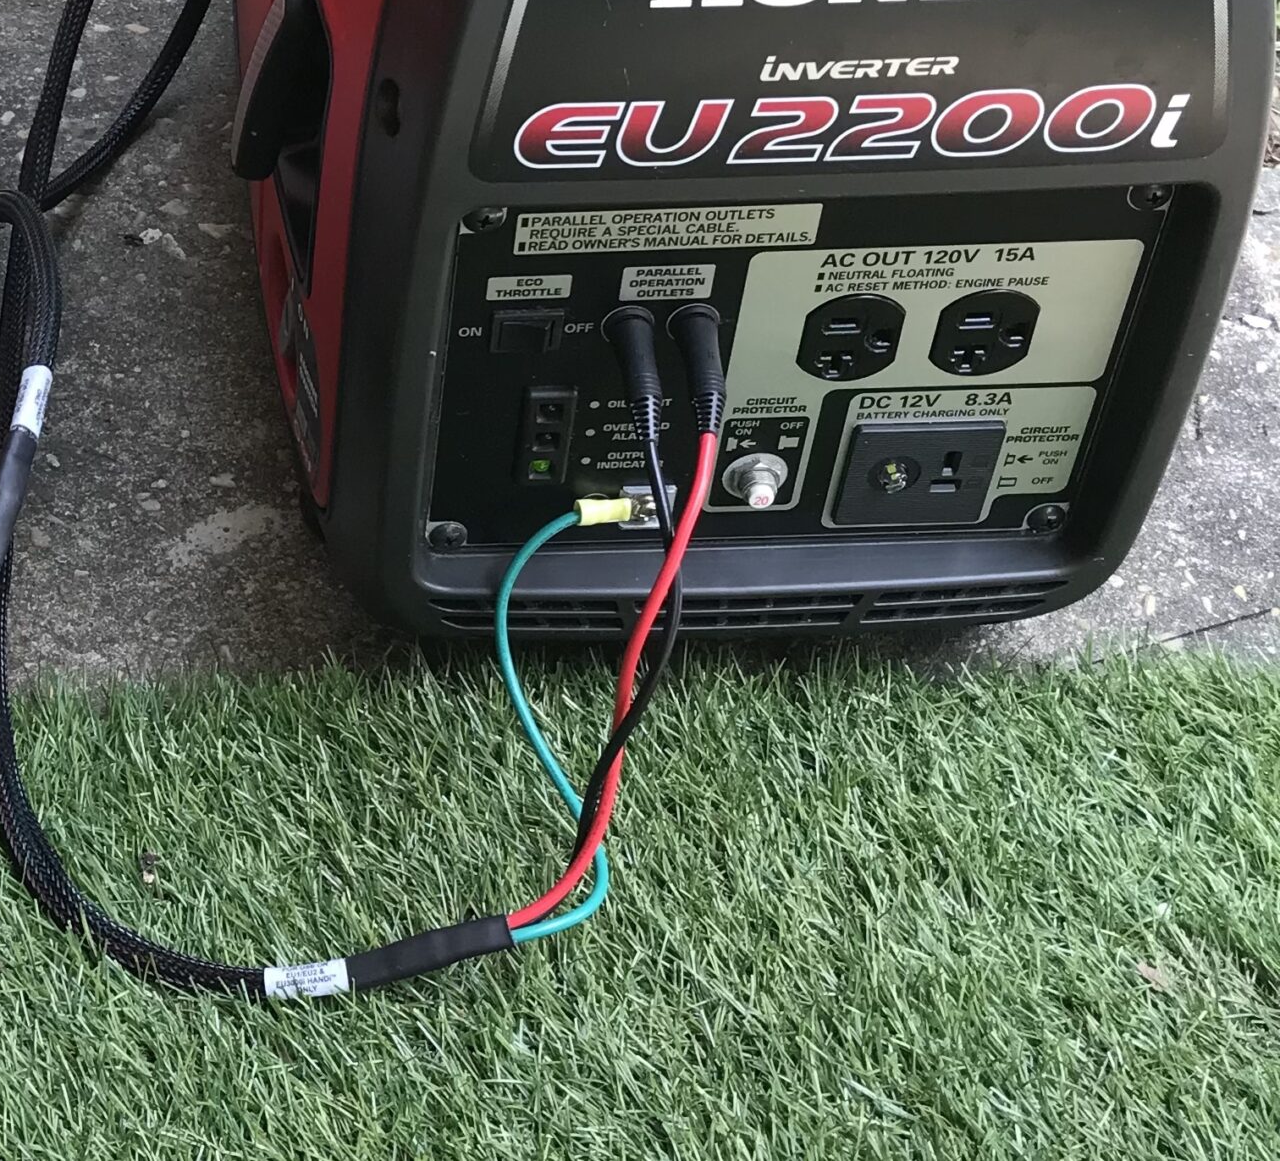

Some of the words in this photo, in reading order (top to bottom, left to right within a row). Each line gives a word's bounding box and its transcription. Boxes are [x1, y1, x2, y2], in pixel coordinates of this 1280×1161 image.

[531, 215, 607, 229] PARALLEL
[611, 211, 702, 226] OPERATION
[705, 208, 776, 223] OUTLETS
[529, 225, 598, 240] REQUIRE
[603, 225, 612, 237] A
[617, 222, 681, 237] SPECIAL
[684, 220, 740, 234] CABLE.
[527, 238, 569, 252] READ
[571, 236, 640, 250] OWNER'S
[643, 234, 710, 249] MANUAL
[712, 233, 744, 246] FOR
[745, 231, 813, 244] DETAILS.
[820, 251, 855, 269] AC
[862, 250, 917, 268] OUT
[922, 248, 980, 266] 120V
[994, 246, 1037, 263] 15A
[636, 267, 703, 278] PARALLEL
[828, 270, 887, 281] NEUTRAL
[891, 268, 955, 279] FLOATING
[516, 277, 544, 288] ECO
[629, 277, 706, 288] OPERATION
[824, 283, 844, 293] AC
[847, 281, 890, 293] RESET
[892, 280, 952, 291] METHOD:
[955, 278, 1005, 290] ENGINE
[1007, 276, 1050, 288] PAUSE
[495, 287, 562, 299] THROTTLE
[636, 287, 695, 298] OUTLETS
[458, 326, 483, 338] ON
[564, 322, 594, 334] OFF
[607, 399, 627, 408] OIL
[746, 397, 798, 407] CIRCUIT
[858, 395, 892, 410] DC
[899, 393, 942, 409] 12V
[965, 392, 1013, 406] 8.3A
[732, 404, 807, 415] PROTECTOR
[856, 410, 910, 421] BATTERY
[913, 408, 976, 419] CHARGING
[979, 407, 1009, 417] ONLY
[730, 419, 761, 429] PUSH
[780, 421, 804, 430] OFF
[735, 428, 753, 437] ON
[1020, 426, 1071, 435] CIRCUIT
[1006, 433, 1079, 443] PROTECTOR
[1038, 450, 1068, 458] PUSH
[1042, 457, 1059, 466] ON
[1031, 476, 1054, 485] OFF
[754, 496, 769, 505] 20
